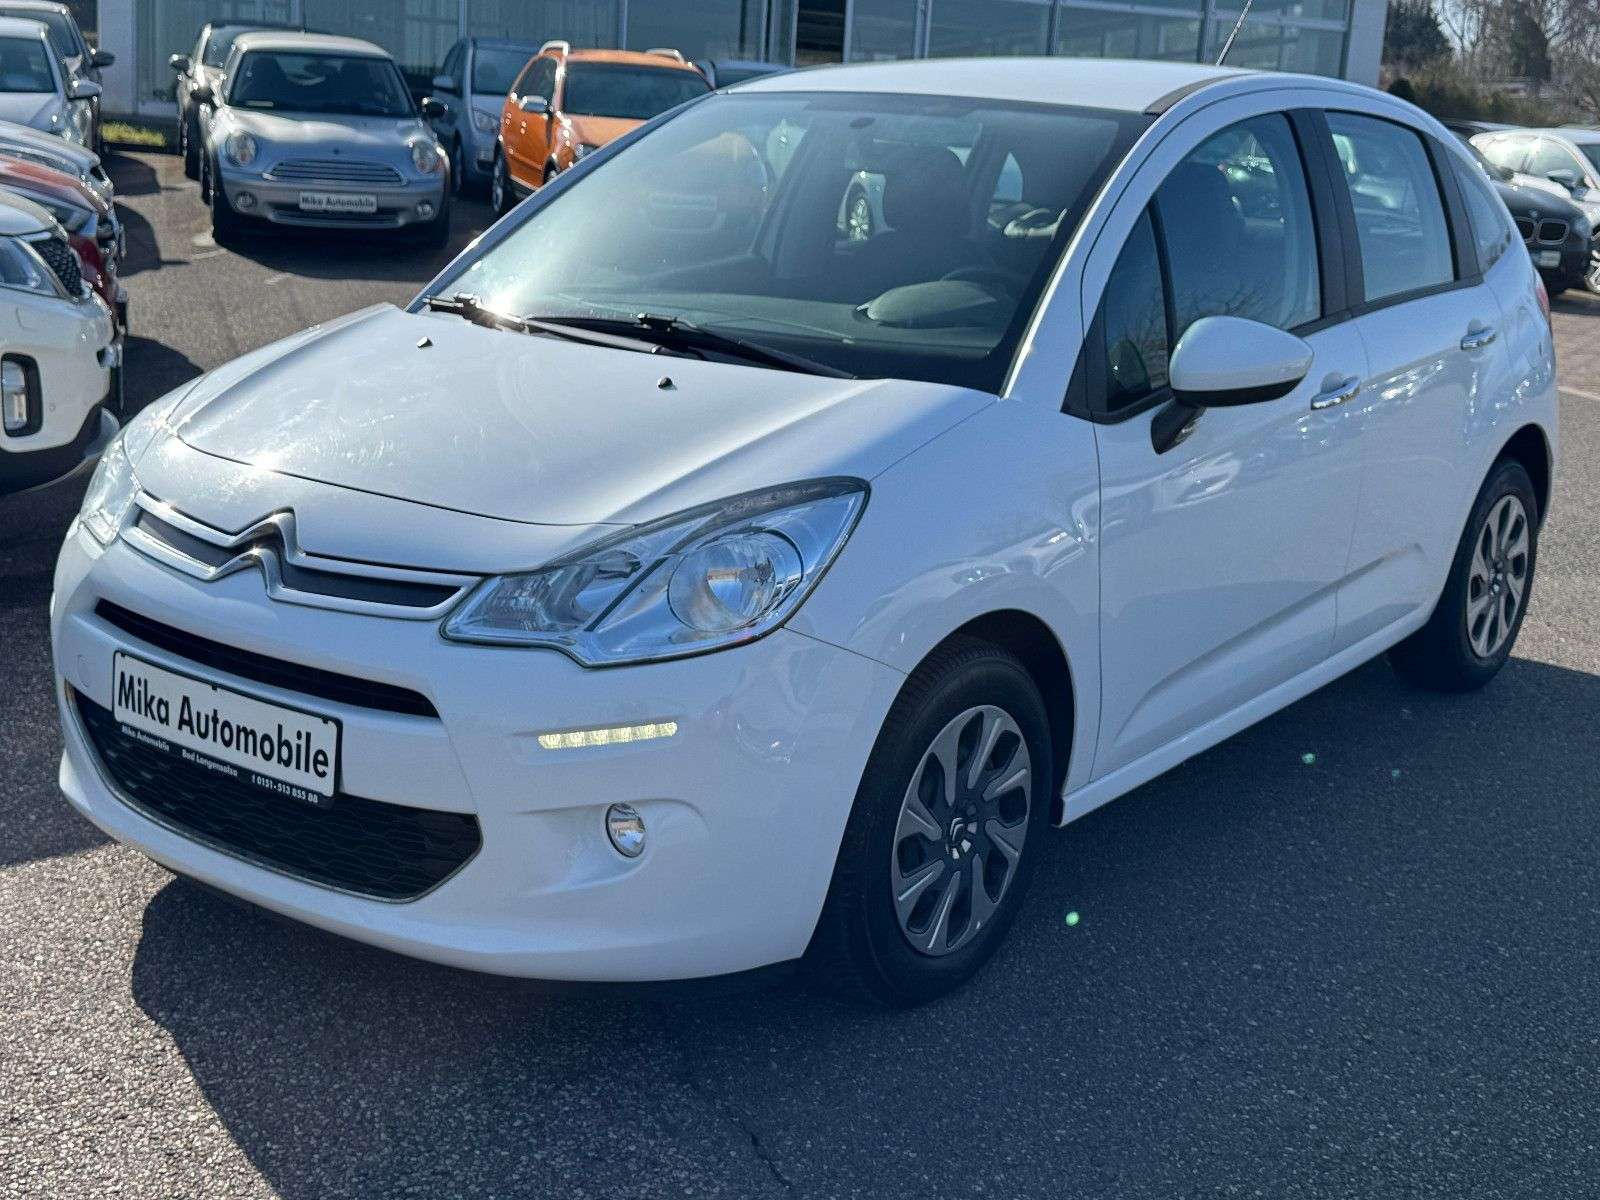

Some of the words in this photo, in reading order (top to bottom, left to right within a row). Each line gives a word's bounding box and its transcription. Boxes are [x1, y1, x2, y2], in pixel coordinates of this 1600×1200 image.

[301, 196, 323, 207] Mika
[326, 196, 375, 209] Automobile
[118, 671, 170, 726] Mika
[178, 696, 329, 778] Automobile
[182, 749, 195, 761] Bad
